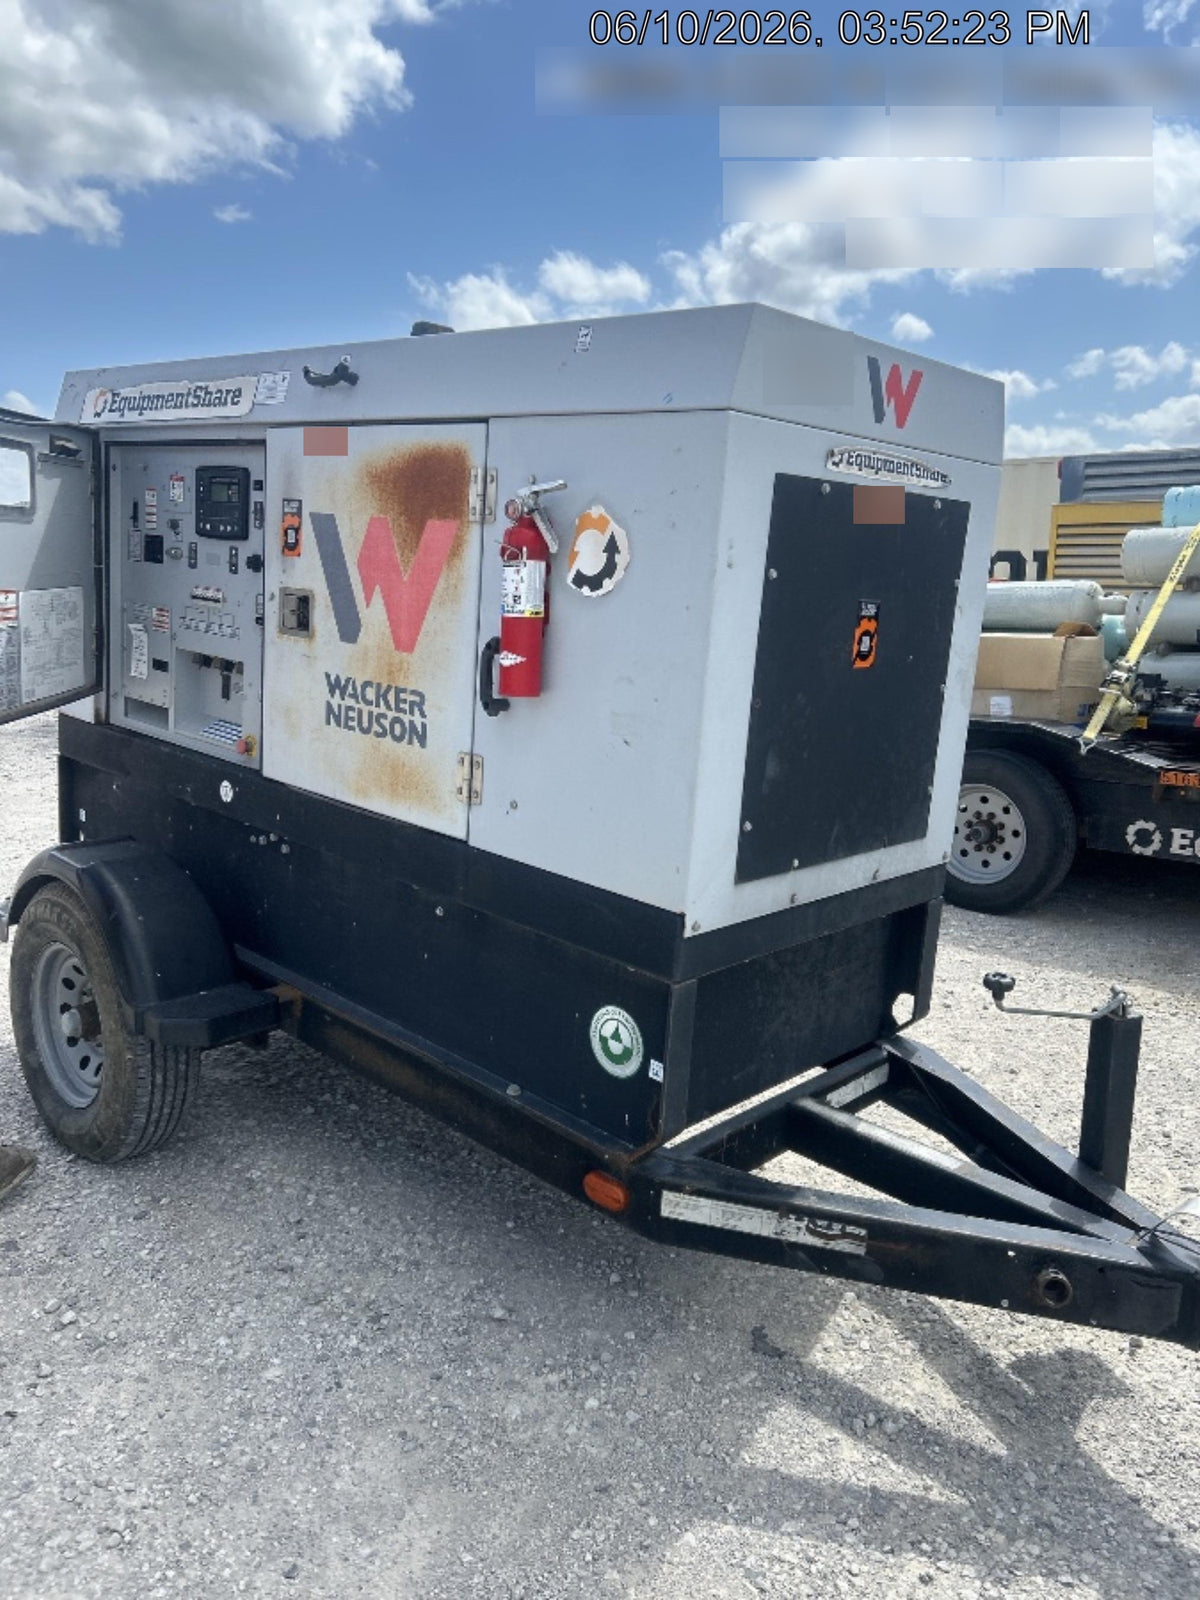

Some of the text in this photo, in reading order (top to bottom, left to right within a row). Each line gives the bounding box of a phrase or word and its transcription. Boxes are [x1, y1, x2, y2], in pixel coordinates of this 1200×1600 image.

[108, 386, 242, 417] EquipmentShare
[325, 671, 427, 719] WACKER
[325, 700, 428, 749] NEUSON
